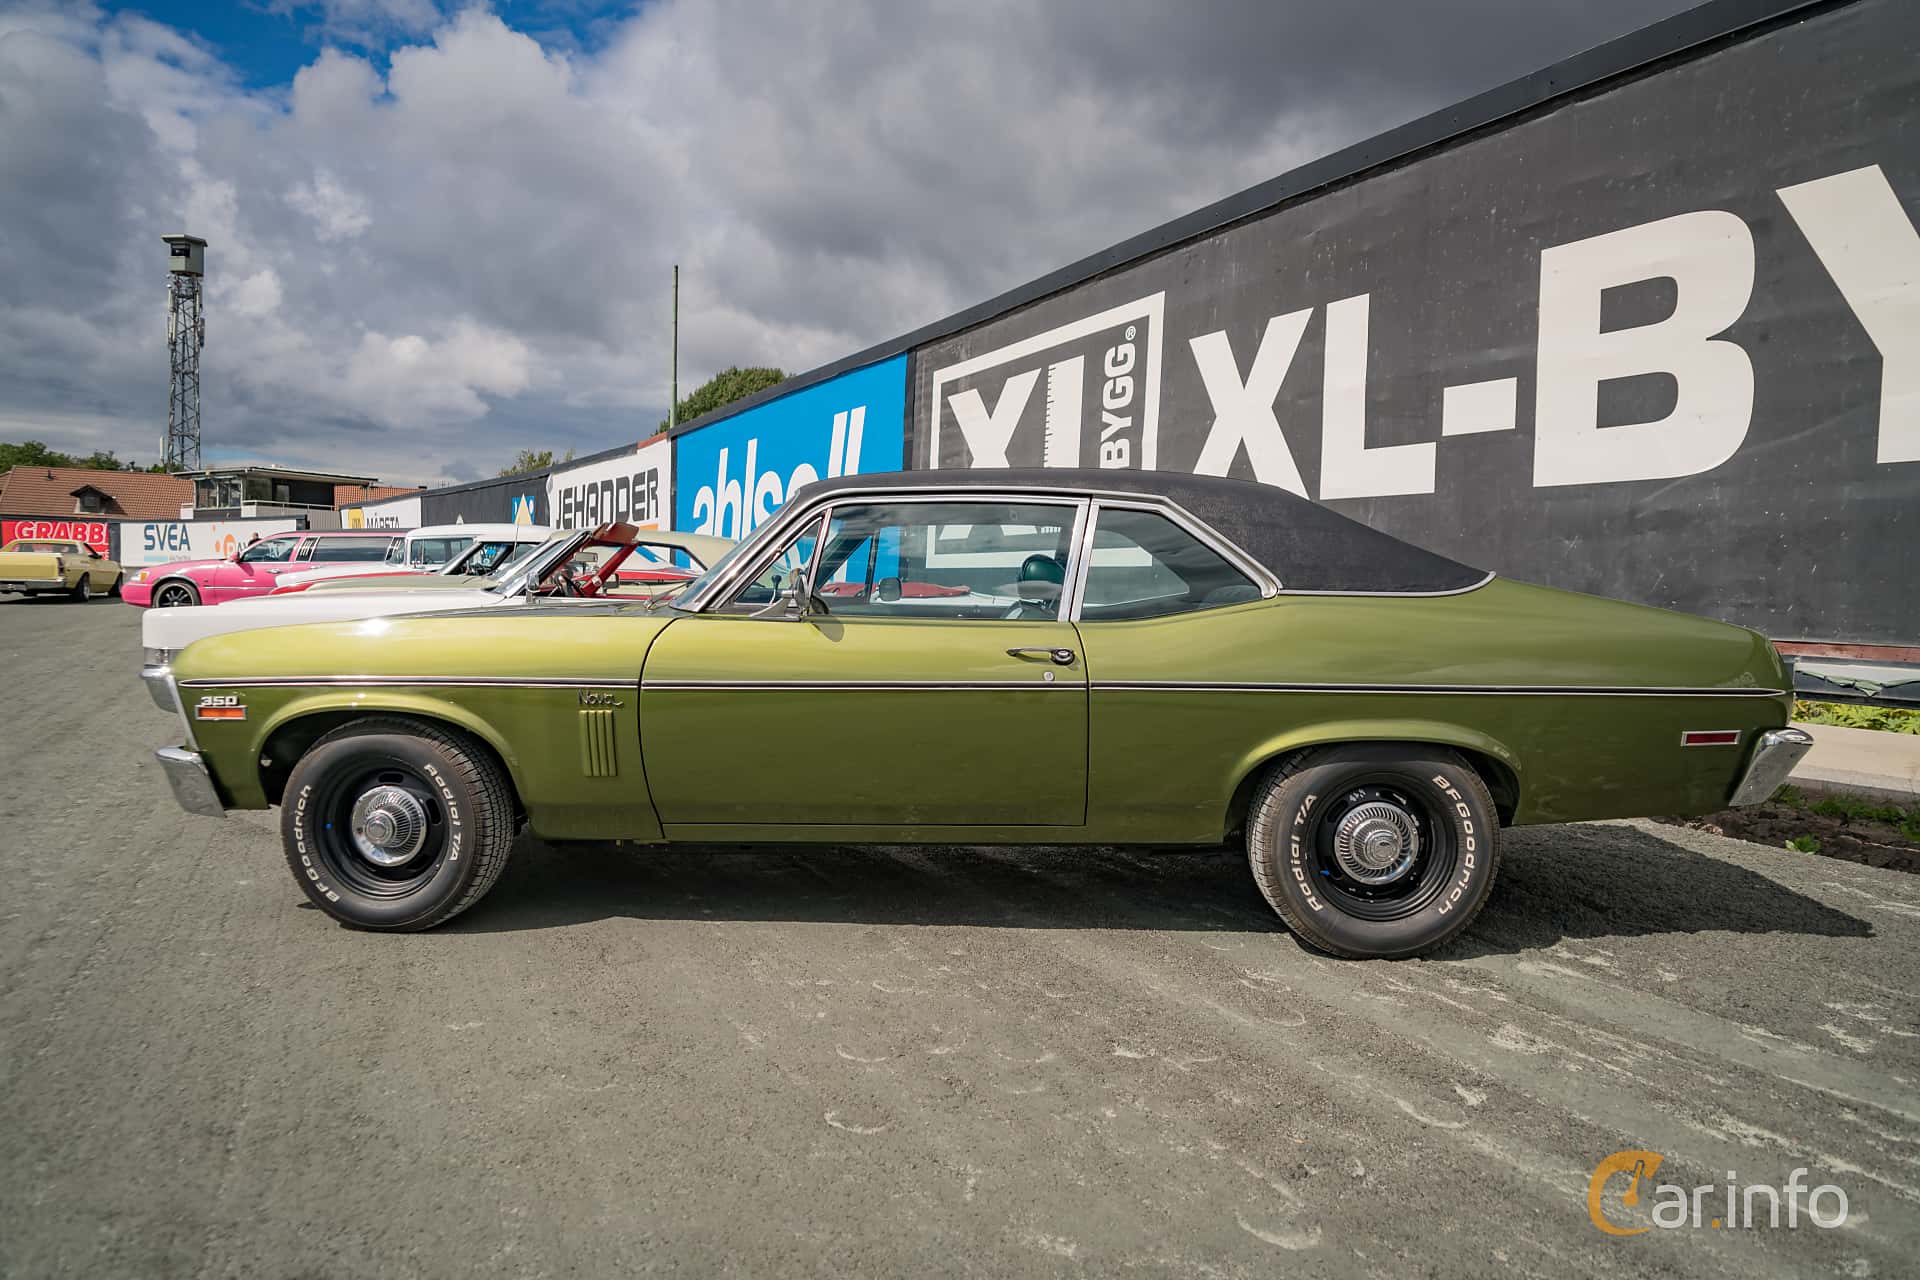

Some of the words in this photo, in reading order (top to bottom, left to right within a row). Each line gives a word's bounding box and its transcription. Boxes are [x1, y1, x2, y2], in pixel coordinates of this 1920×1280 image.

[556, 467, 659, 530] JEHANDER
[15, 521, 109, 545] GRABB
[144, 523, 191, 551] SVEA
[201, 695, 239, 706] 350
[424, 763, 461, 832] Radial
[449, 833, 464, 862] T/A
[1294, 794, 1318, 826] T/A
[293, 784, 340, 903] BFGoodrich
[1290, 834, 1324, 912] Radial
[1432, 775, 1476, 915] BFGoodrich
